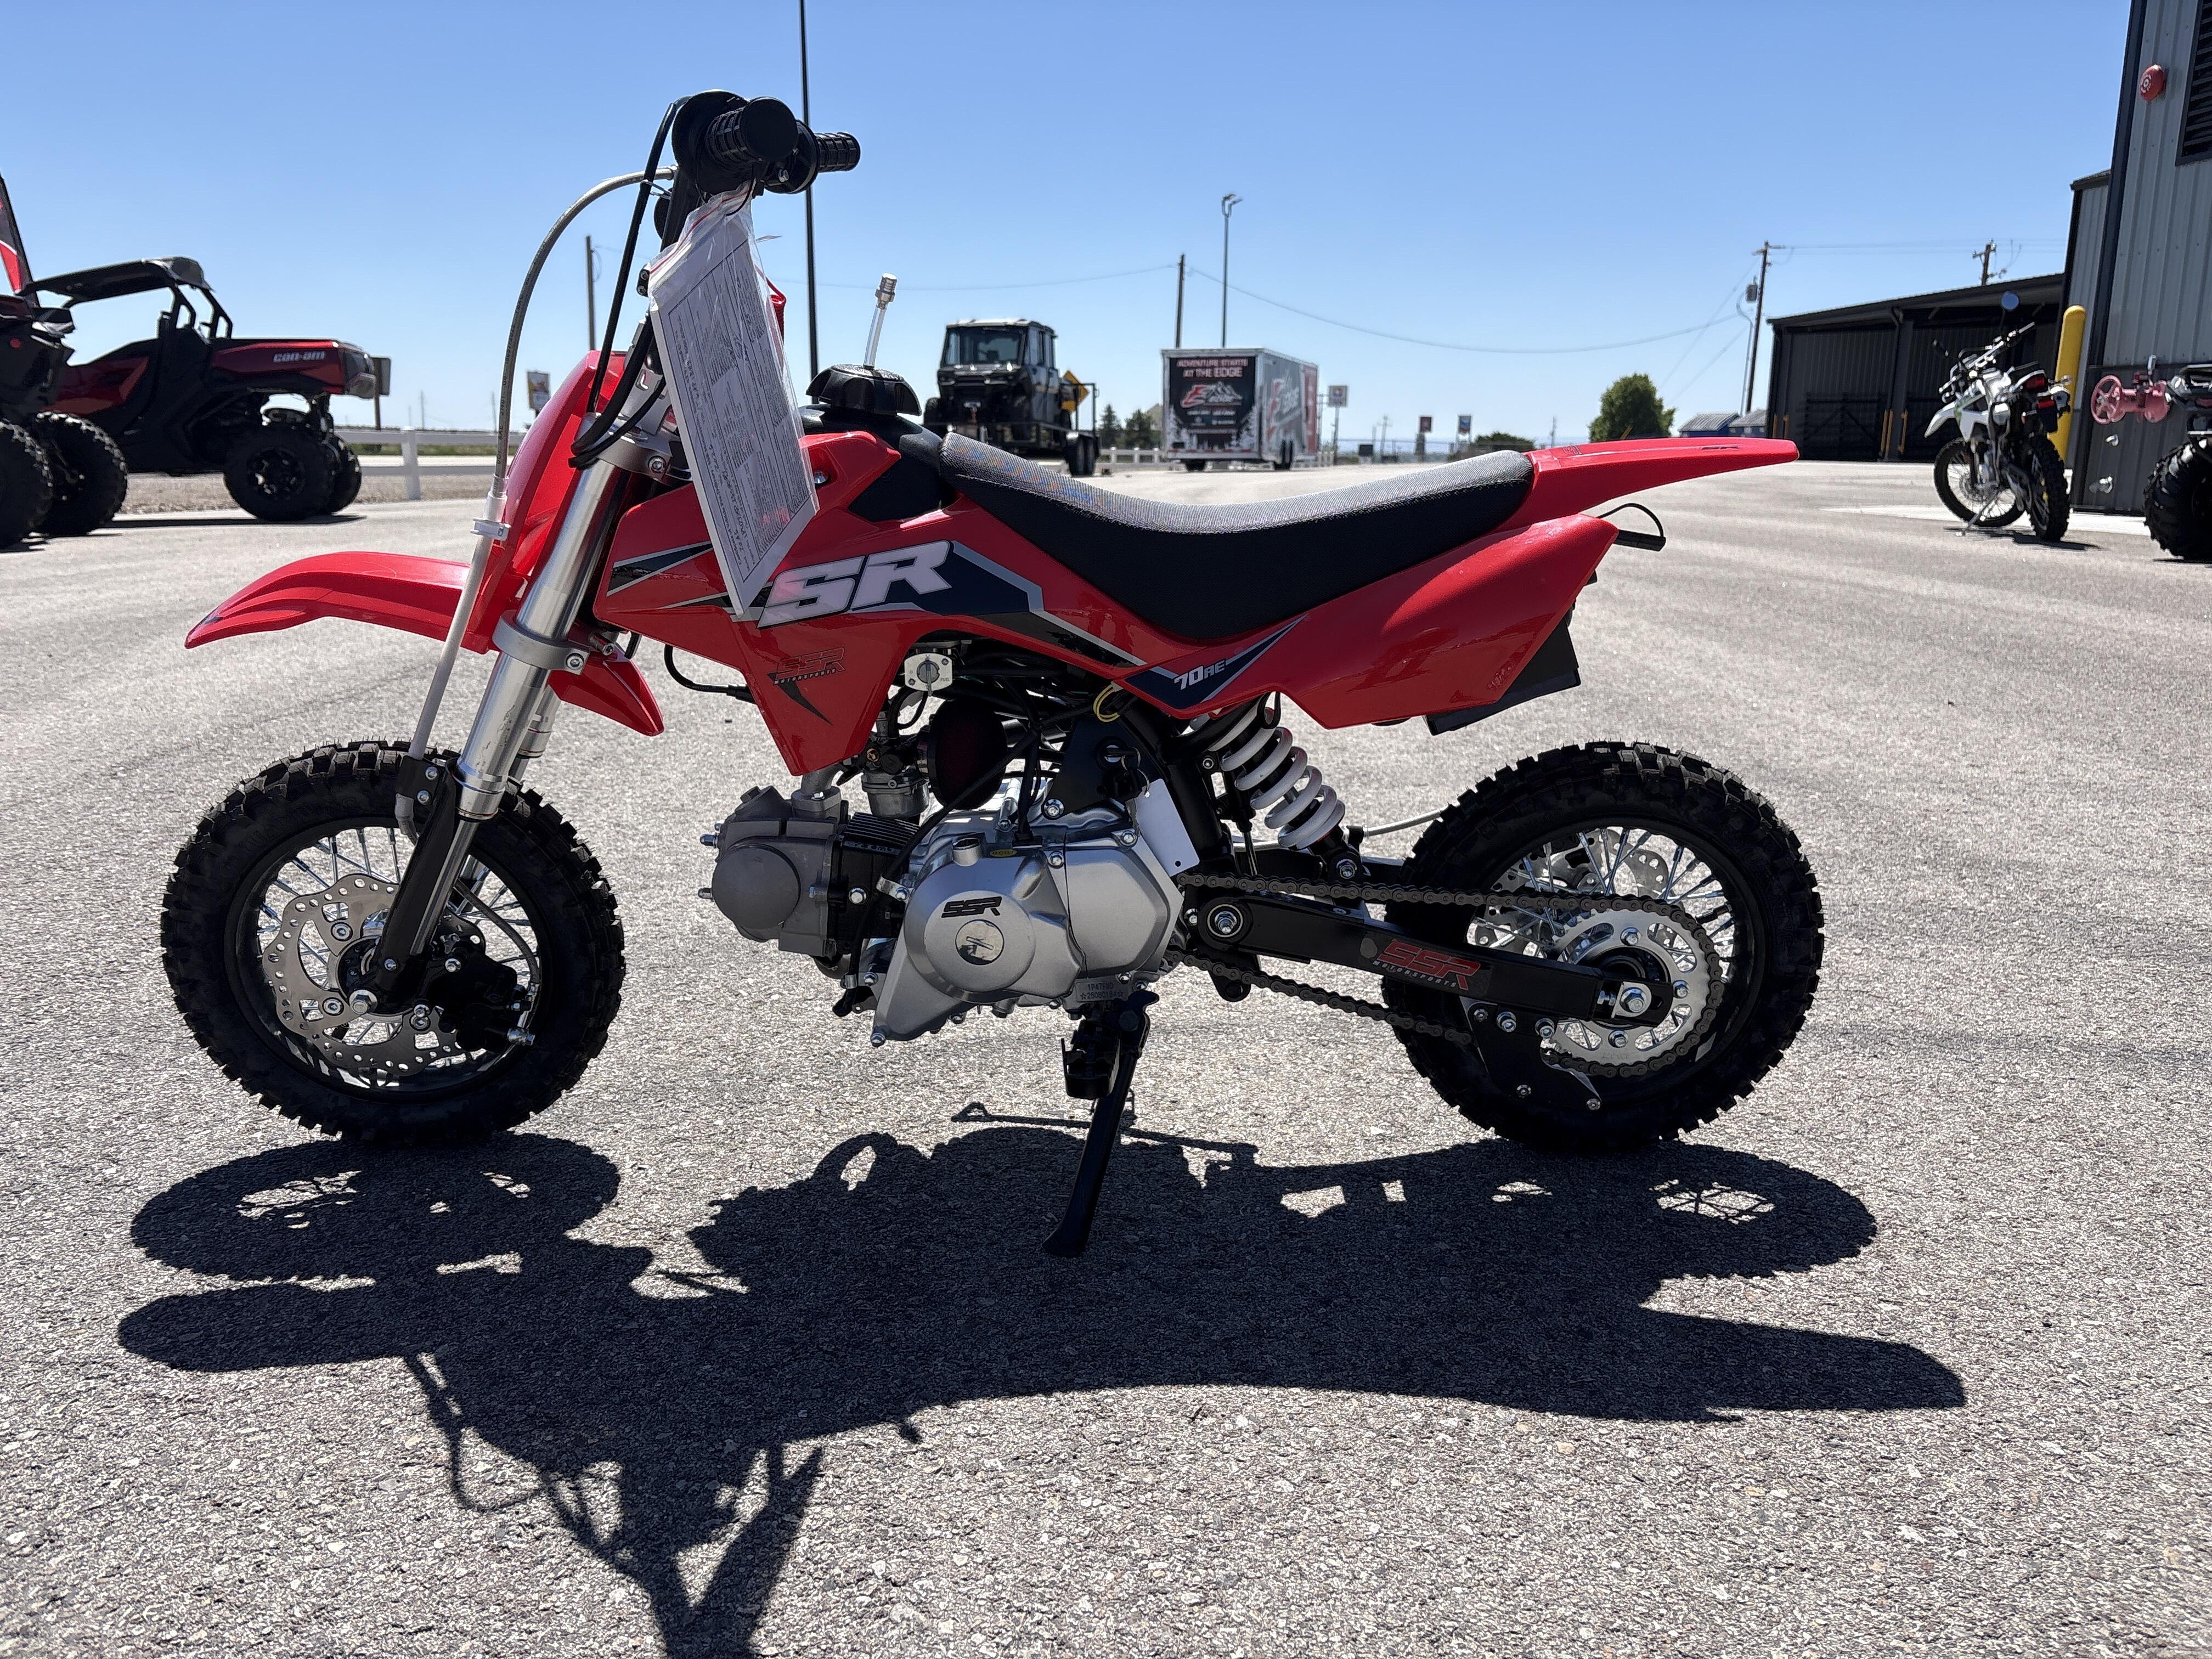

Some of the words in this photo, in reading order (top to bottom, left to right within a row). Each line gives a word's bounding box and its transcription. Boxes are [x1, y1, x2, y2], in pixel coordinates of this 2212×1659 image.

[273, 351, 325, 363] can-am
[1214, 366, 1243, 377] EDGE
[775, 647, 846, 679] SSR
[774, 668, 836, 685] MOTORSPORTS
[941, 896, 1002, 918] SSR
[1372, 960, 1457, 988] MOTORSPORTS
[1376, 940, 1481, 991] SSR
